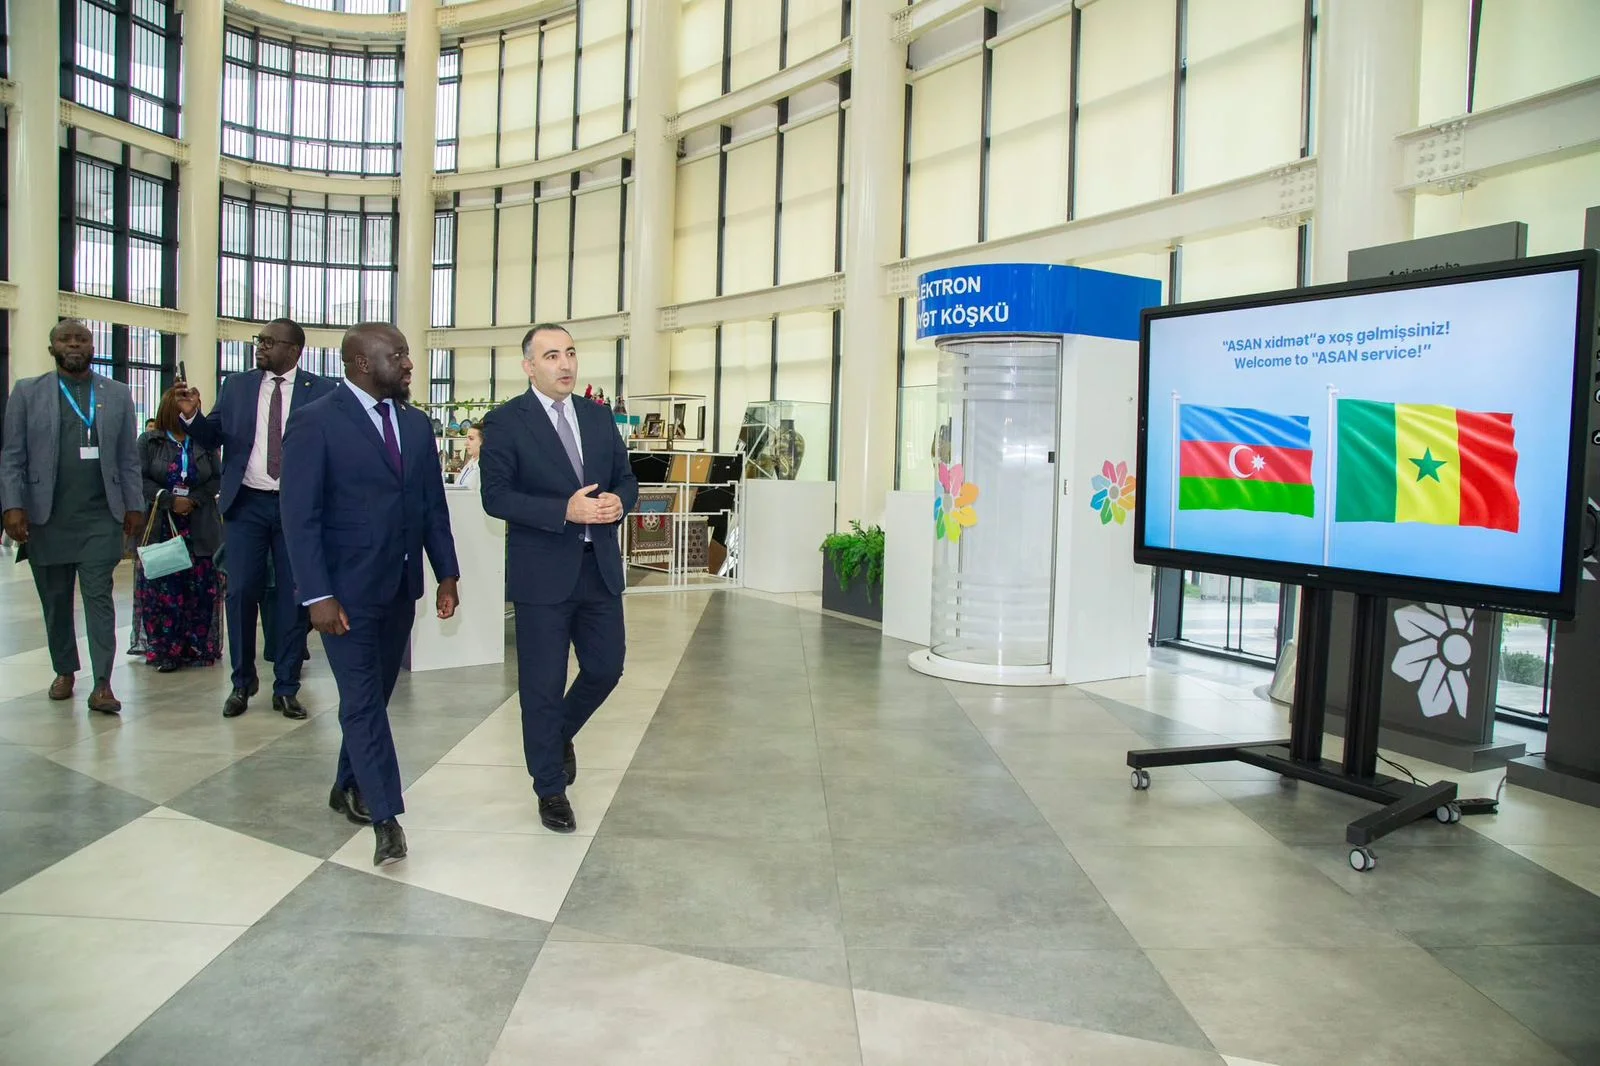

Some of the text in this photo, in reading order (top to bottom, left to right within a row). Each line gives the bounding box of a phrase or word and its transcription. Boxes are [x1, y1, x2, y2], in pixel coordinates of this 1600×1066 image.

[940, 301, 1009, 328] KÖŞKÜ
[1328, 333, 1354, 346] xoş
[1356, 320, 1450, 345] gəlmişsiniz!
[1234, 355, 1292, 369] Welcome
[1294, 353, 1309, 366] to
